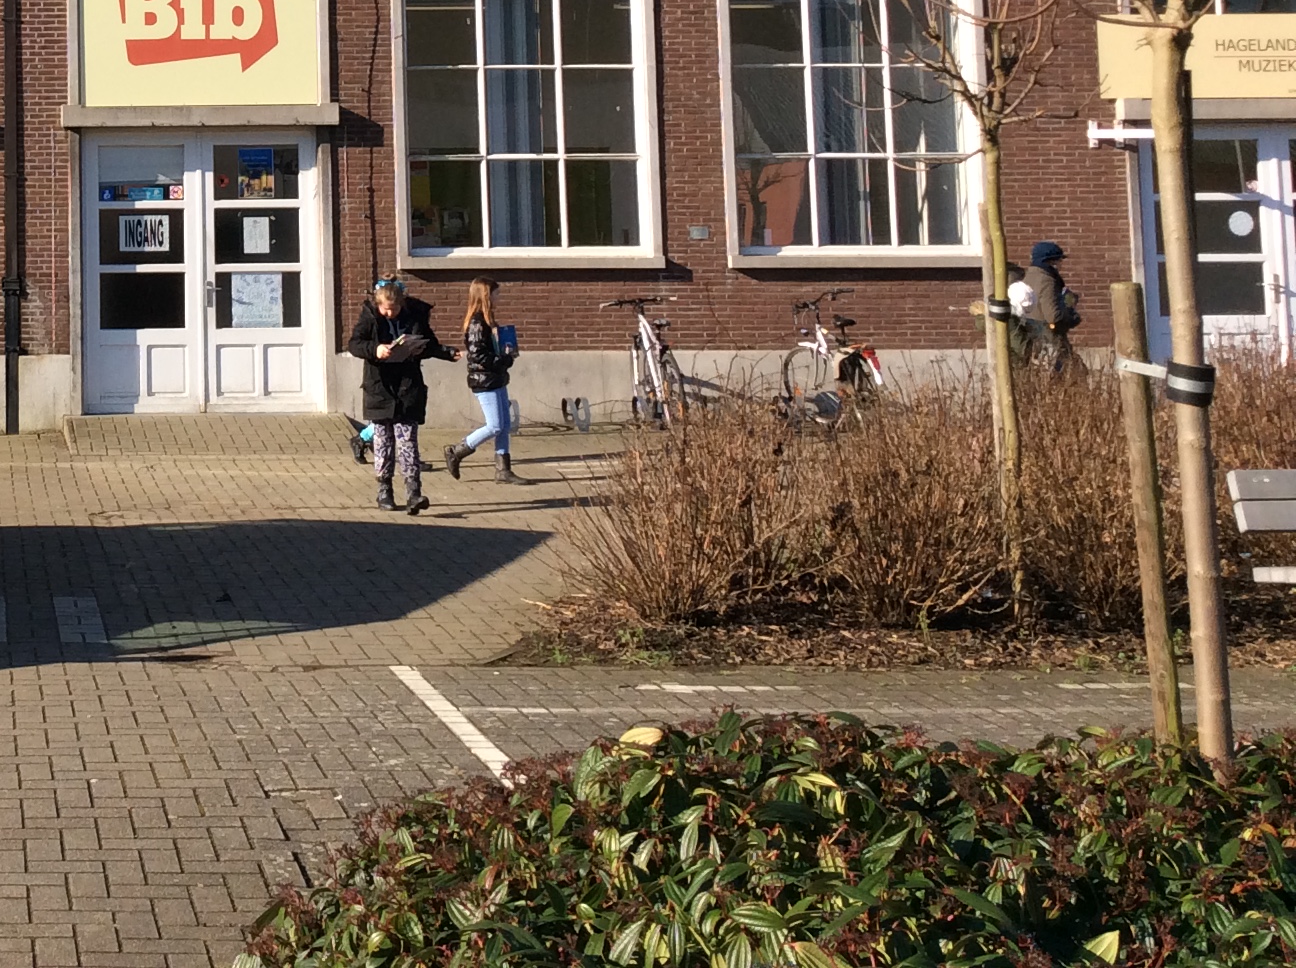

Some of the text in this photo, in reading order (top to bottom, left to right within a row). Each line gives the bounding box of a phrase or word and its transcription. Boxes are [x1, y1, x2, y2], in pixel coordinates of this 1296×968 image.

[1215, 38, 1296, 52] HAGELAND
[1238, 59, 1296, 73] MUZIEK
[124, 218, 164, 248] INGANG
